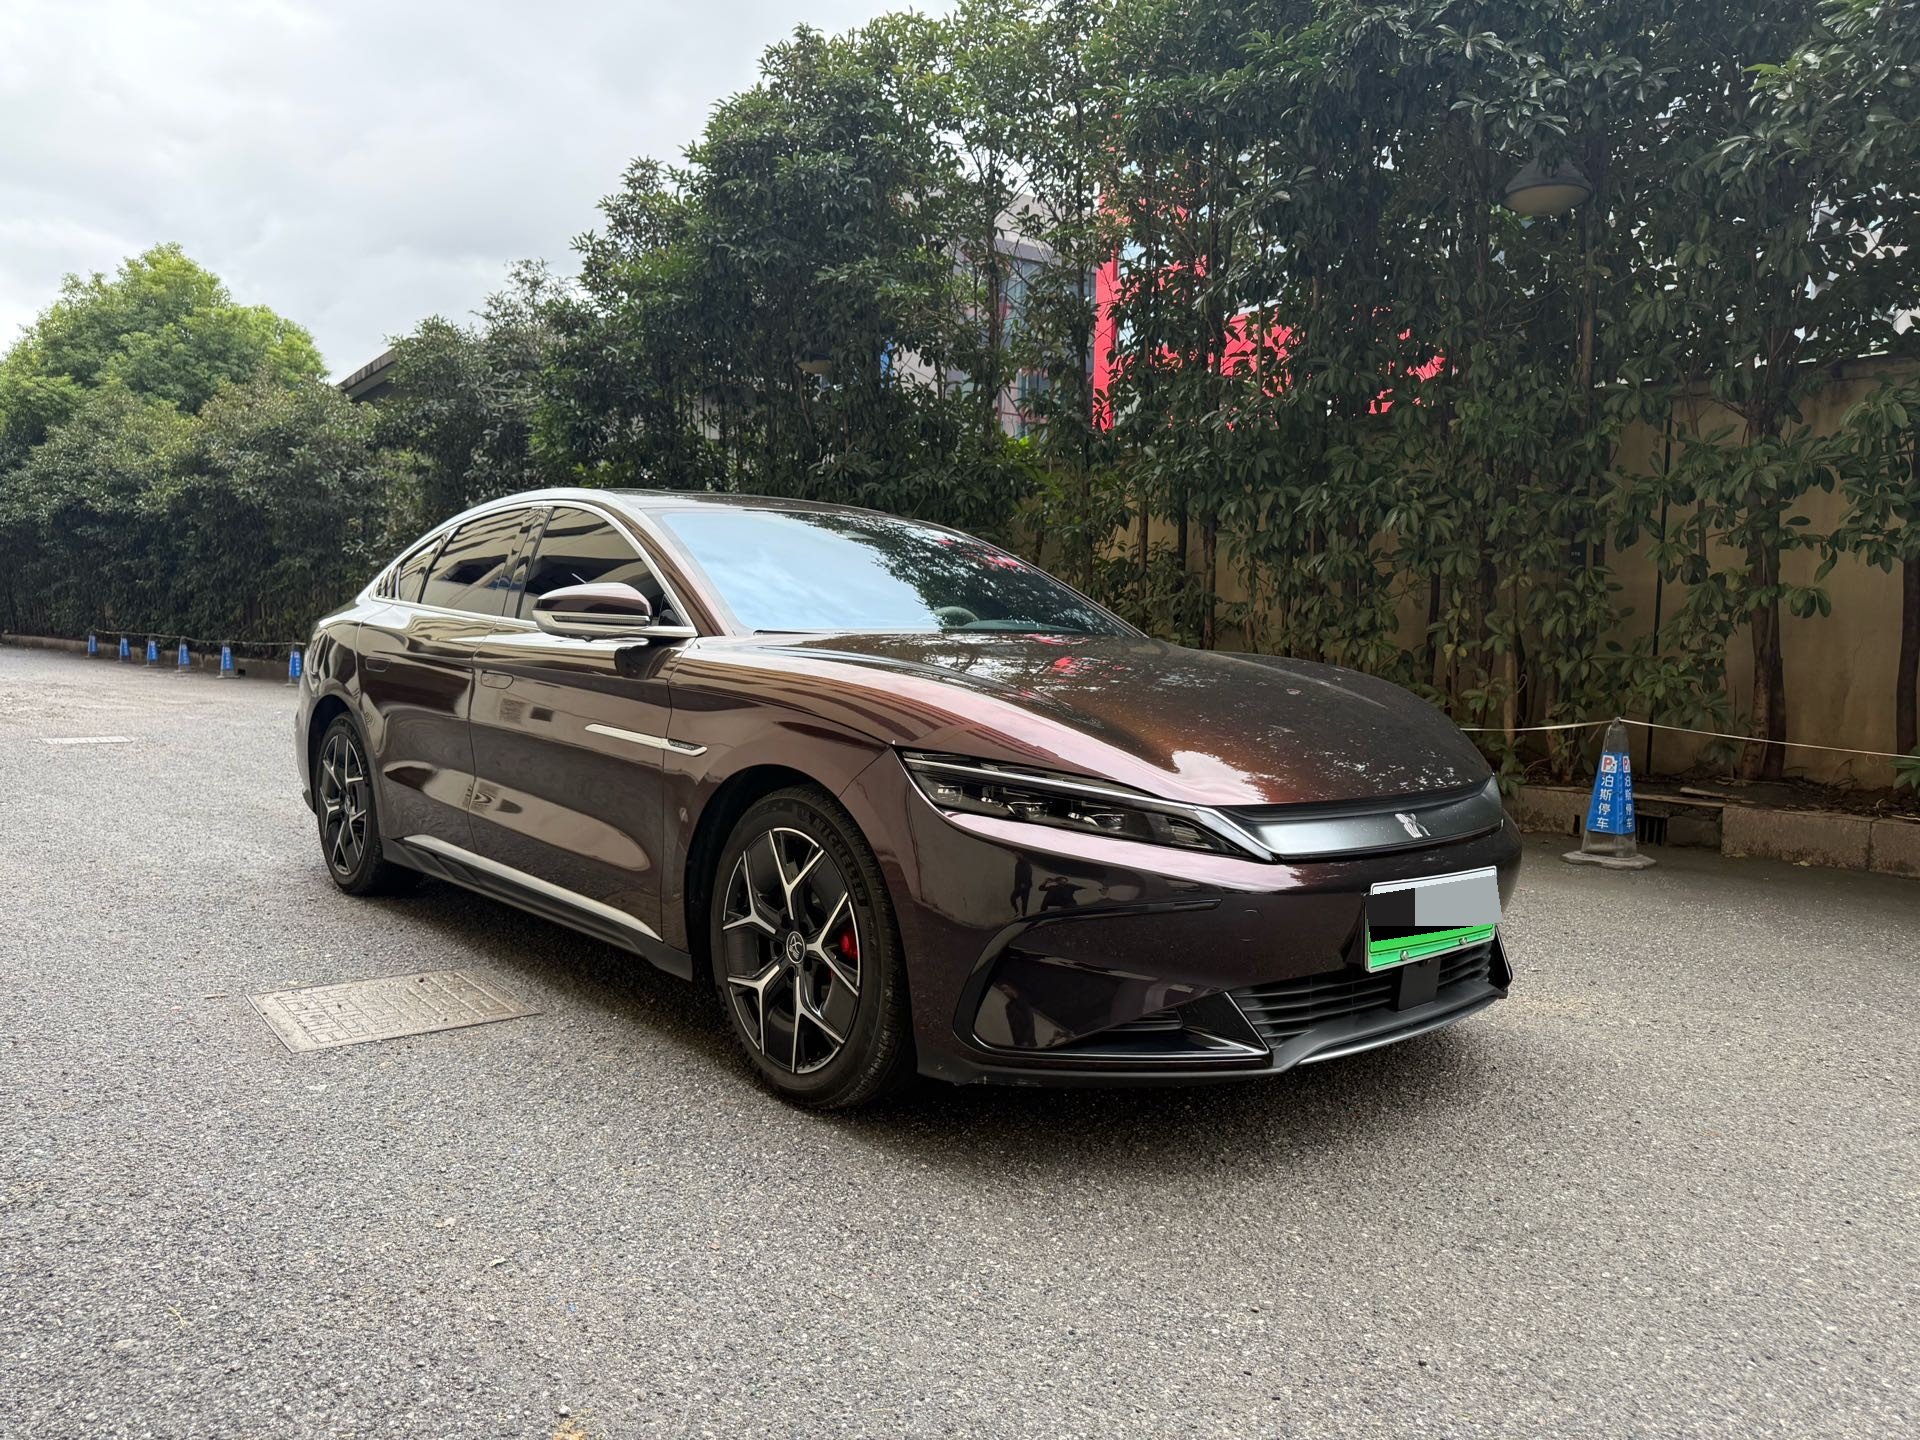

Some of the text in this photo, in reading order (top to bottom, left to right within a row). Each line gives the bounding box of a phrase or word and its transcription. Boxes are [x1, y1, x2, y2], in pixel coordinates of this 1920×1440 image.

[1603, 757, 1613, 771] P
[1596, 775, 1614, 829] 泊斯停车
[812, 818, 867, 901] MICHELIN
